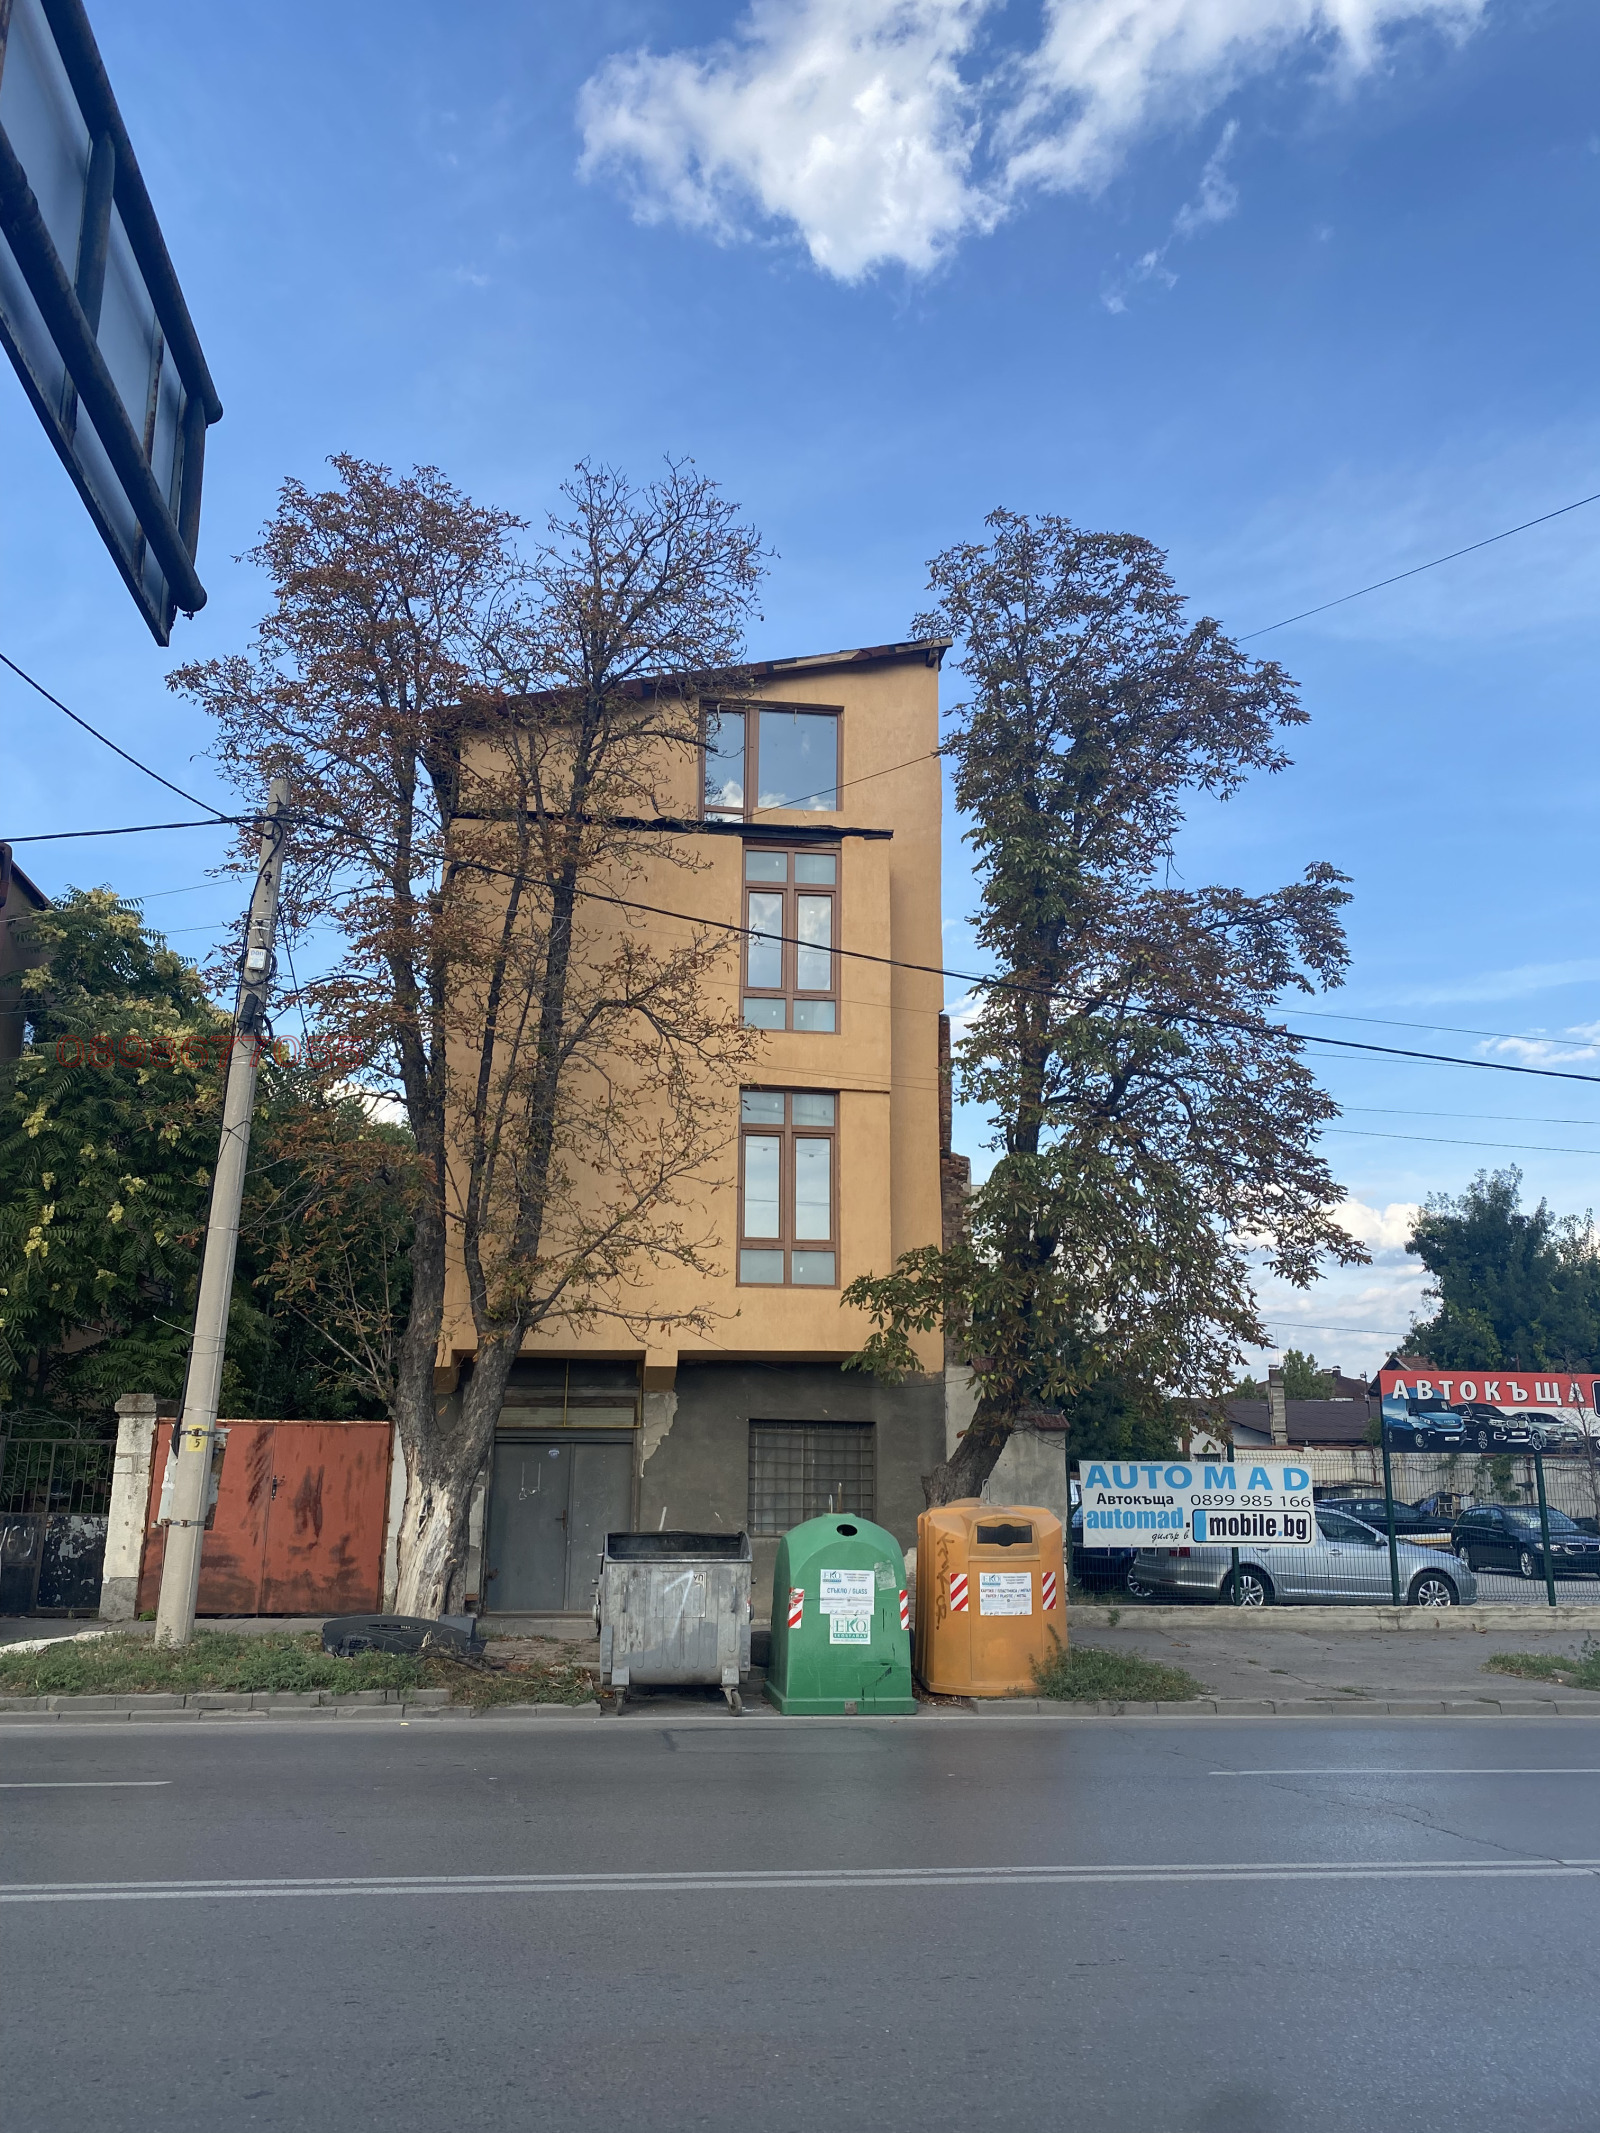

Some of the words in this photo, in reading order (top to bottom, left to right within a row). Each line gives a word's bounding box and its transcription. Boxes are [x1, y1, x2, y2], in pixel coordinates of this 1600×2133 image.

[1392, 1379, 1584, 1406] АВТОКЪЩА
[1085, 1465, 1192, 1489] AUTO
[1096, 1493, 1174, 1508] Автокъща
[1190, 1494, 1235, 1506] 0899
[1240, 1495, 1273, 1507] 985
[1281, 1496, 1311, 1508] 166
[1209, 1513, 1307, 1540] mobile.bg
